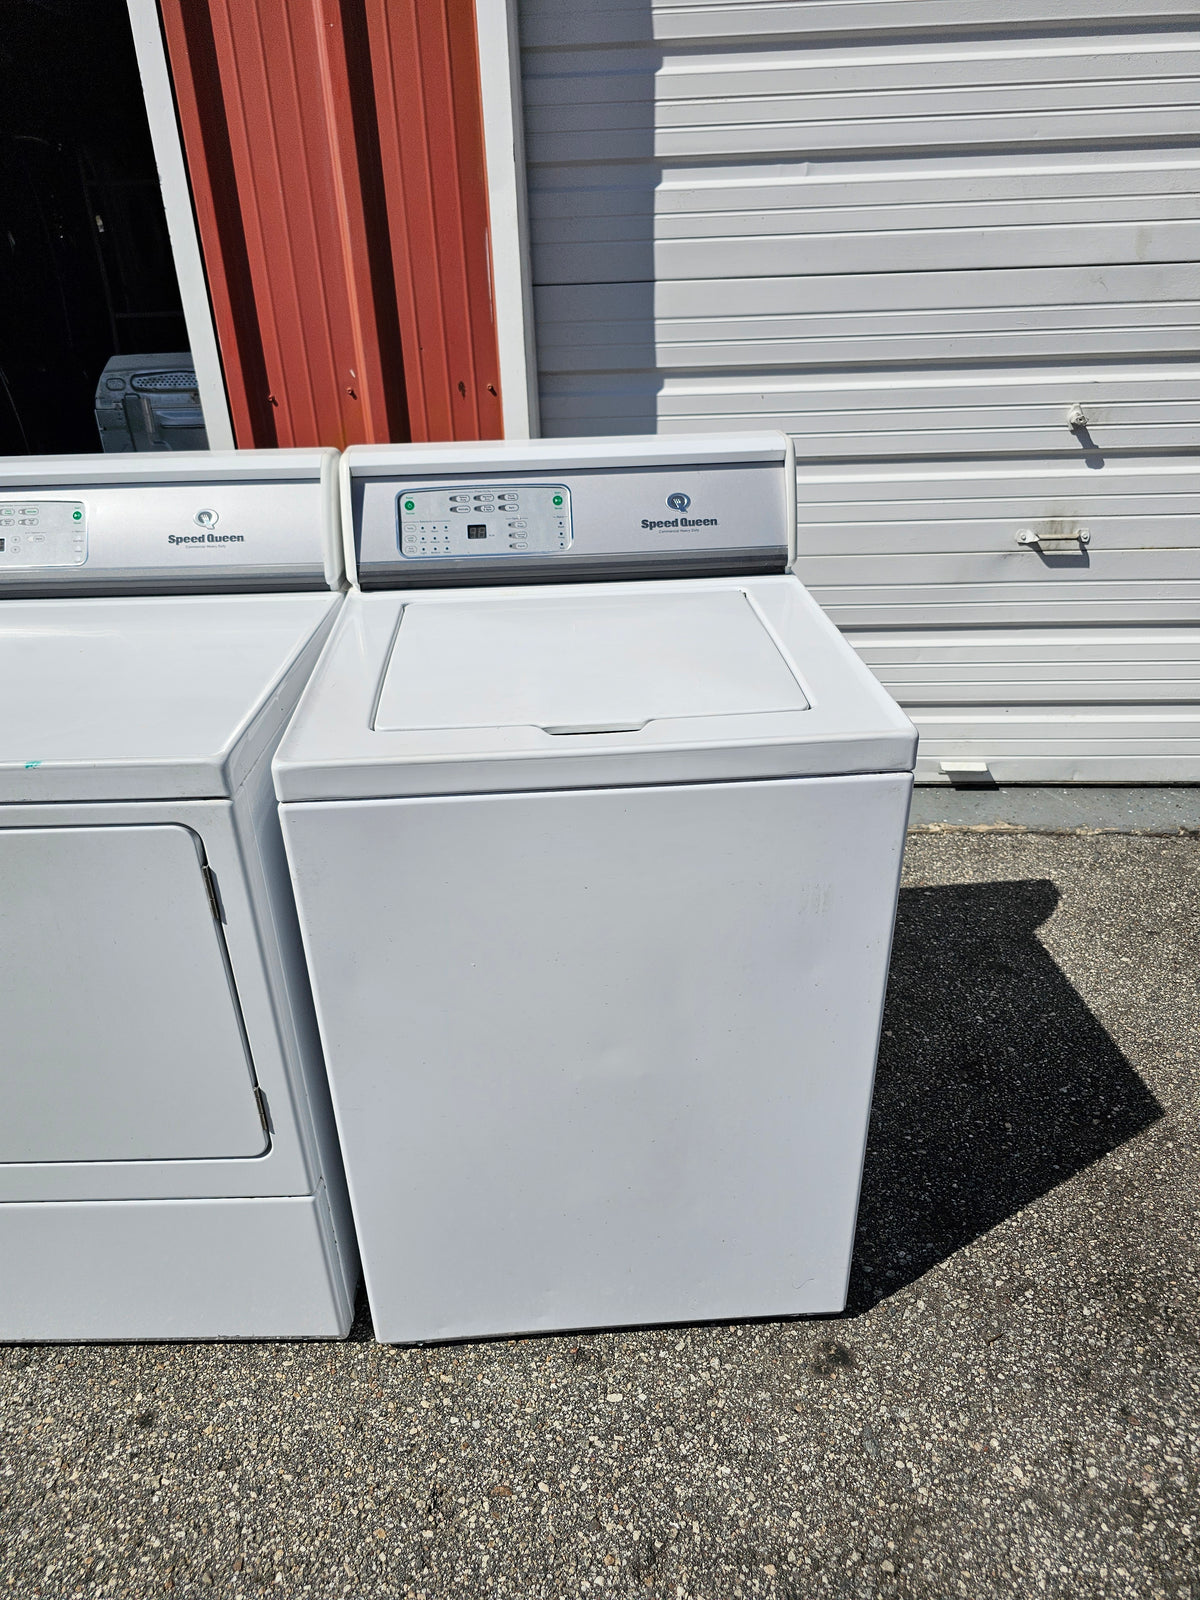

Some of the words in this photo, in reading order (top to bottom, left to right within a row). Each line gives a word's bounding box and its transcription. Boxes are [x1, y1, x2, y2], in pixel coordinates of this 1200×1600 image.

[641, 518, 679, 530] Speed
[680, 517, 718, 527] Queen
[168, 534, 206, 545] Speed
[206, 533, 245, 543] Queen
